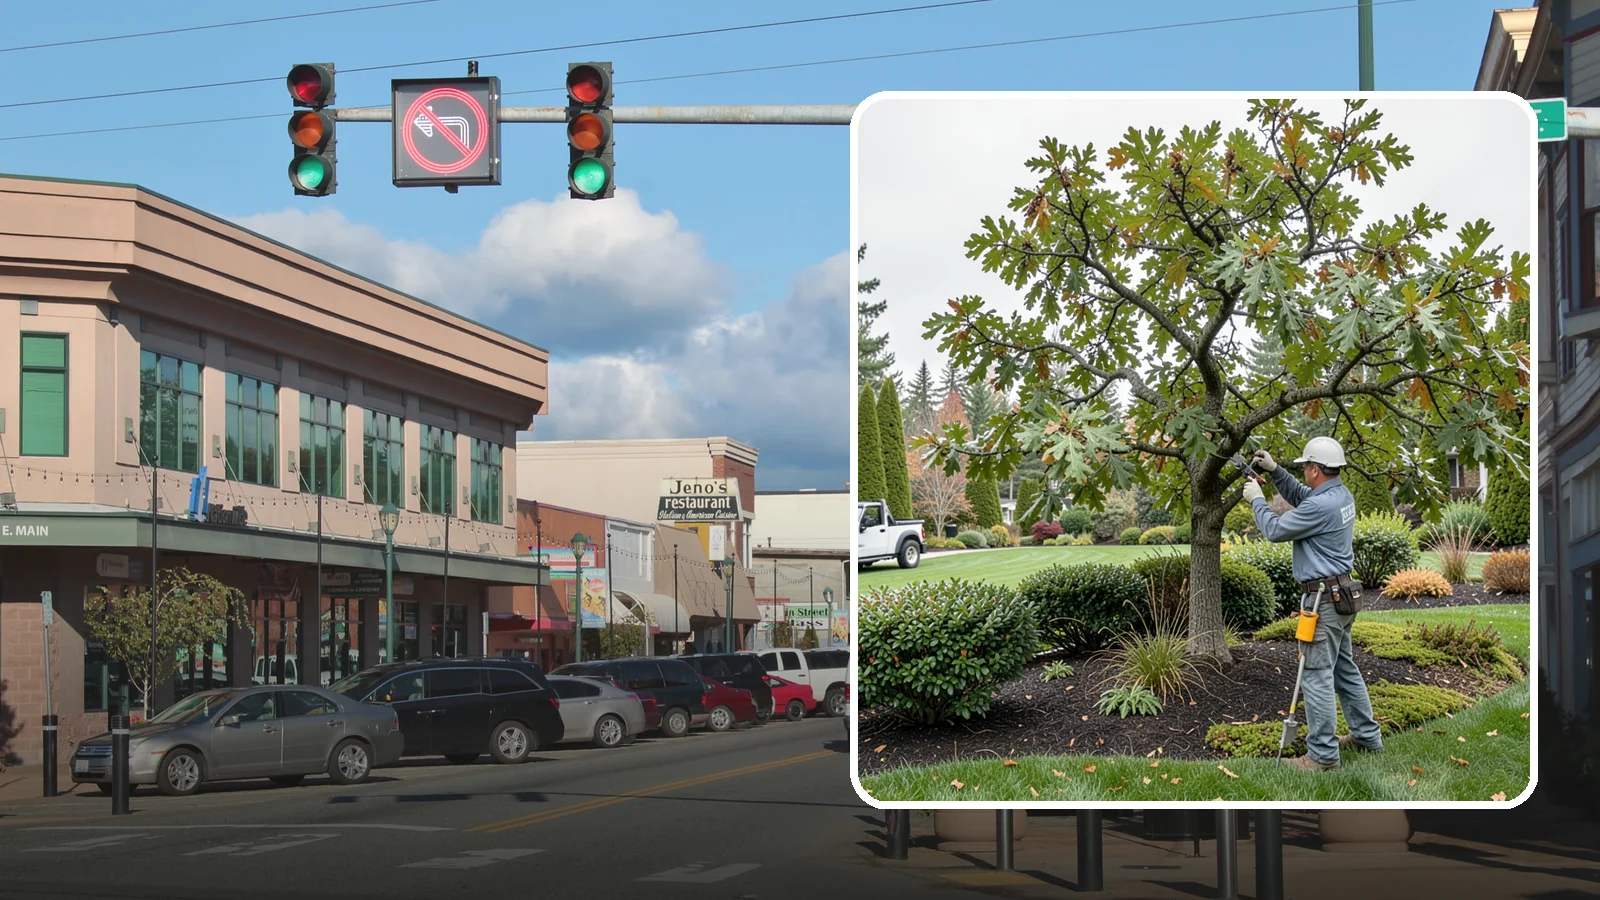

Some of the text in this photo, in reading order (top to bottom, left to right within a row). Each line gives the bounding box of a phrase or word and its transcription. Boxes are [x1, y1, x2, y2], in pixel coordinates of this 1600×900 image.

[670, 480, 727, 495] Jeno's
[665, 497, 731, 509] restaurant
[658, 510, 681, 519] Italian
[686, 510, 714, 519] American
[715, 509, 737, 519] Cuisine
[2, 525, 49, 536] E. MAIN
[786, 607, 828, 616] in Street
[791, 619, 823, 627] lass
